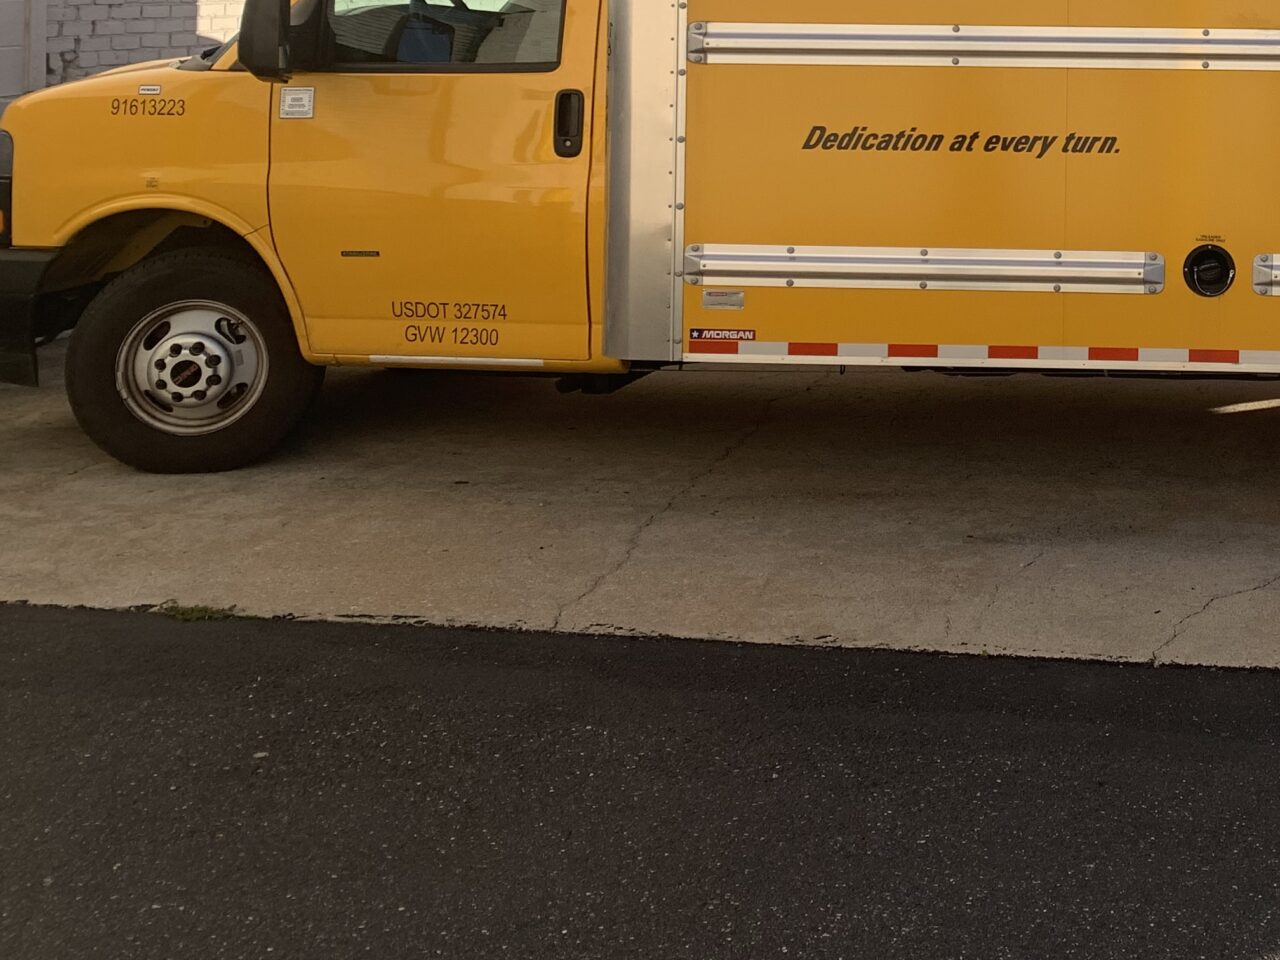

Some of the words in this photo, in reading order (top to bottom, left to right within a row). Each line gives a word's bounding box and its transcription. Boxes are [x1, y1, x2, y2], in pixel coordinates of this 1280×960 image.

[110, 98, 186, 117] 91613223
[801, 125, 945, 152] Dedication
[948, 131, 982, 152] at
[983, 133, 1057, 159] every
[1060, 131, 1121, 154] turn.
[391, 300, 450, 319] USDOT
[453, 302, 508, 321] 327574
[404, 324, 446, 344] GVW
[451, 327, 500, 346] 12300
[701, 330, 755, 340] MORGAN
